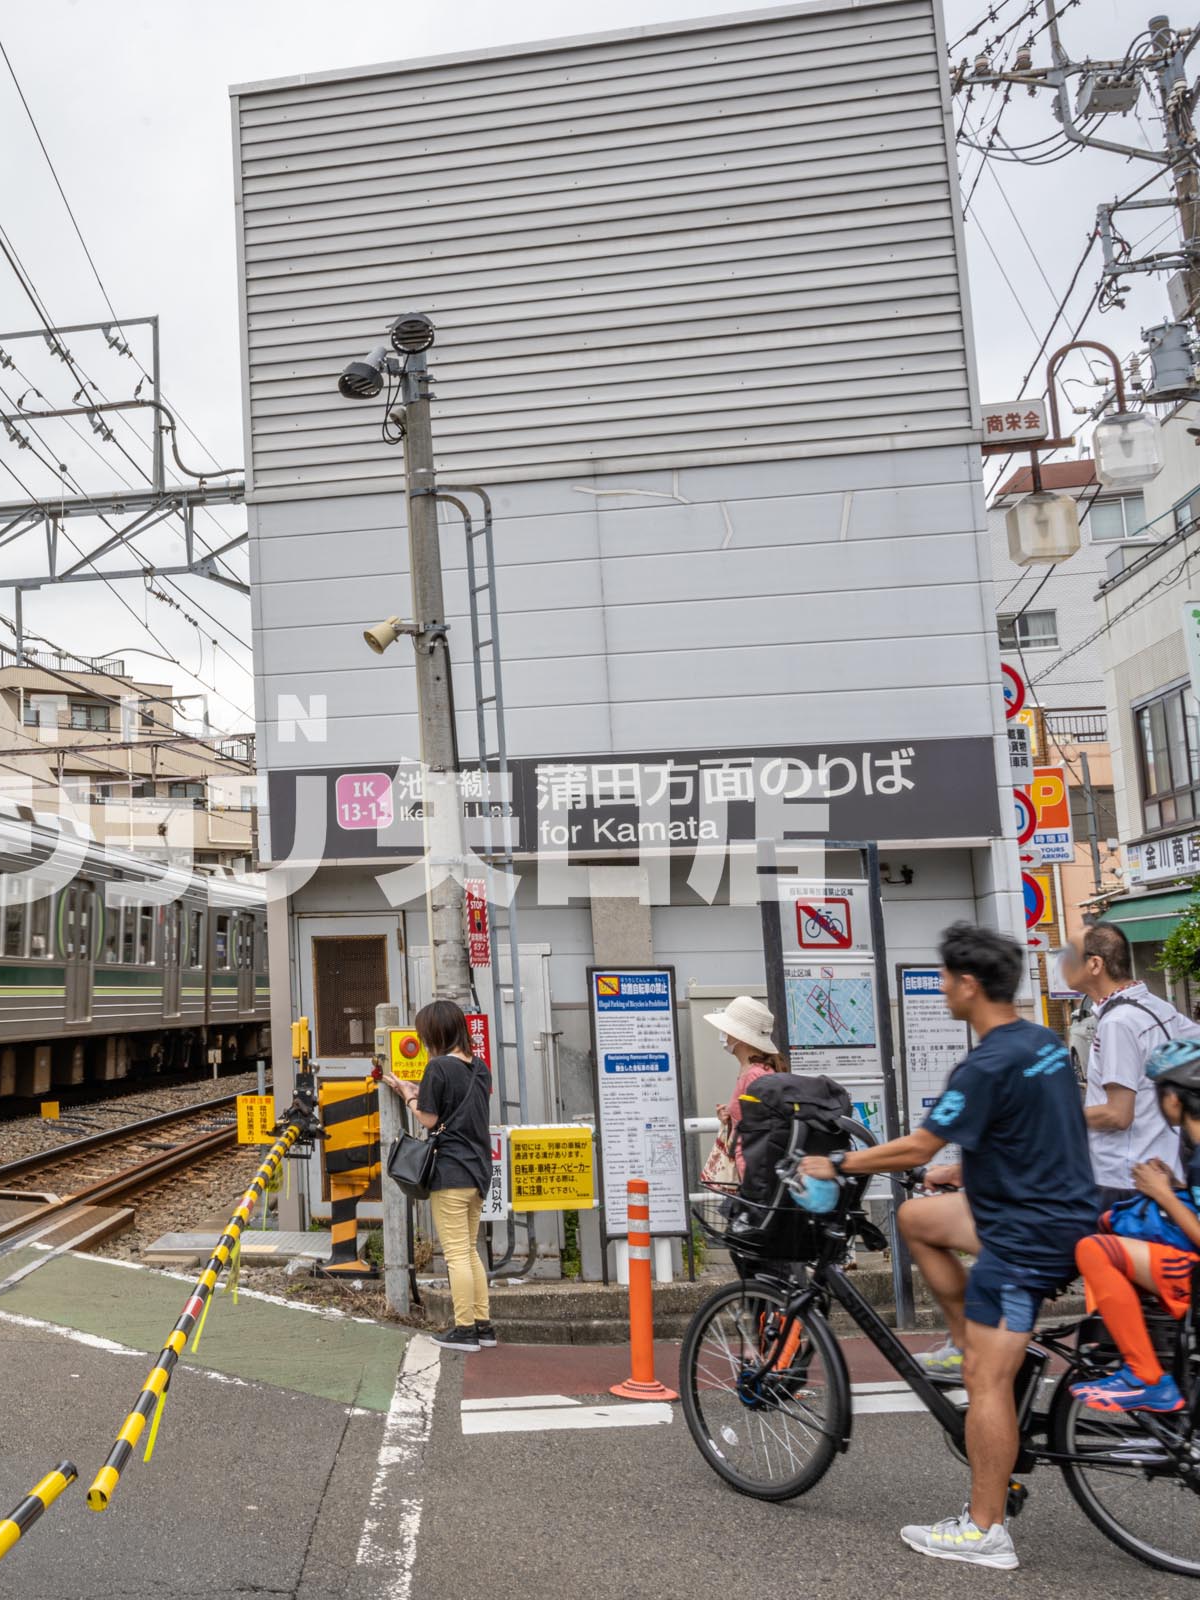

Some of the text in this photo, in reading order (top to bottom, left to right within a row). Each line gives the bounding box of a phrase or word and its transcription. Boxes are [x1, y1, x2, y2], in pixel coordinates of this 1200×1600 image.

[982, 410, 1041, 434] 商栄会
[399, 768, 491, 802] 池線
[536, 747, 917, 812] 蒲田方面のりば
[353, 782, 376, 797] IK
[1031, 775, 1065, 823] P
[341, 803, 390, 821] 13-15
[540, 815, 719, 845] for Kamata
[470, 900, 483, 910] STOP
[620, 983, 668, 995] 放置自転車の禁止
[393, 1069, 427, 1079] 非常ボタ
[514, 1142, 587, 1152] 踏切には、列車の車輪が
[515, 1151, 584, 1160] 通過する溝があります。
[515, 1175, 578, 1184] などで通行する際は、
[515, 1185, 578, 1197] 溝に注意して下さい。
